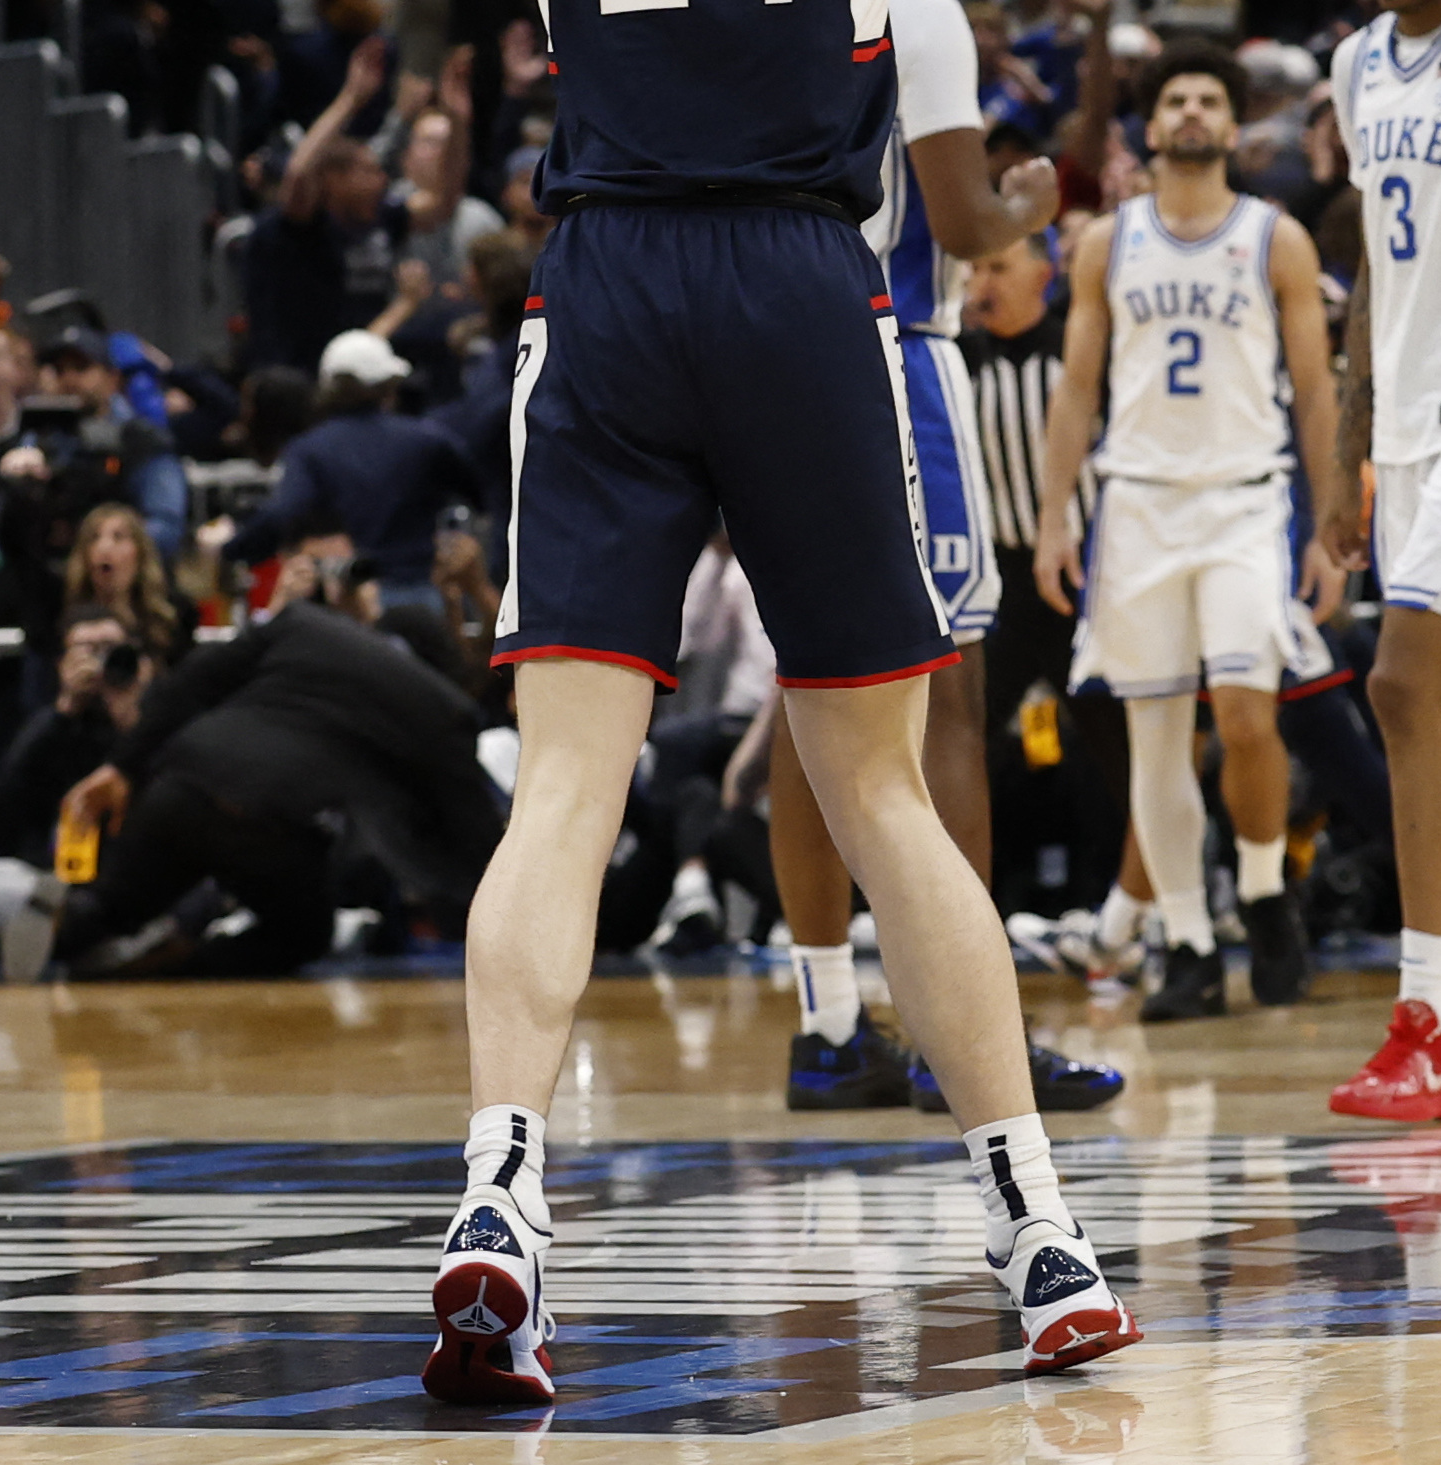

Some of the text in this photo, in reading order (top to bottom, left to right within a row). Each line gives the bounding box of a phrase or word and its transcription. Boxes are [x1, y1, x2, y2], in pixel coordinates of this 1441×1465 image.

[1381, 176, 1416, 260] 3
[1125, 281, 1250, 328] DUKE
[1169, 329, 1201, 394] 2
